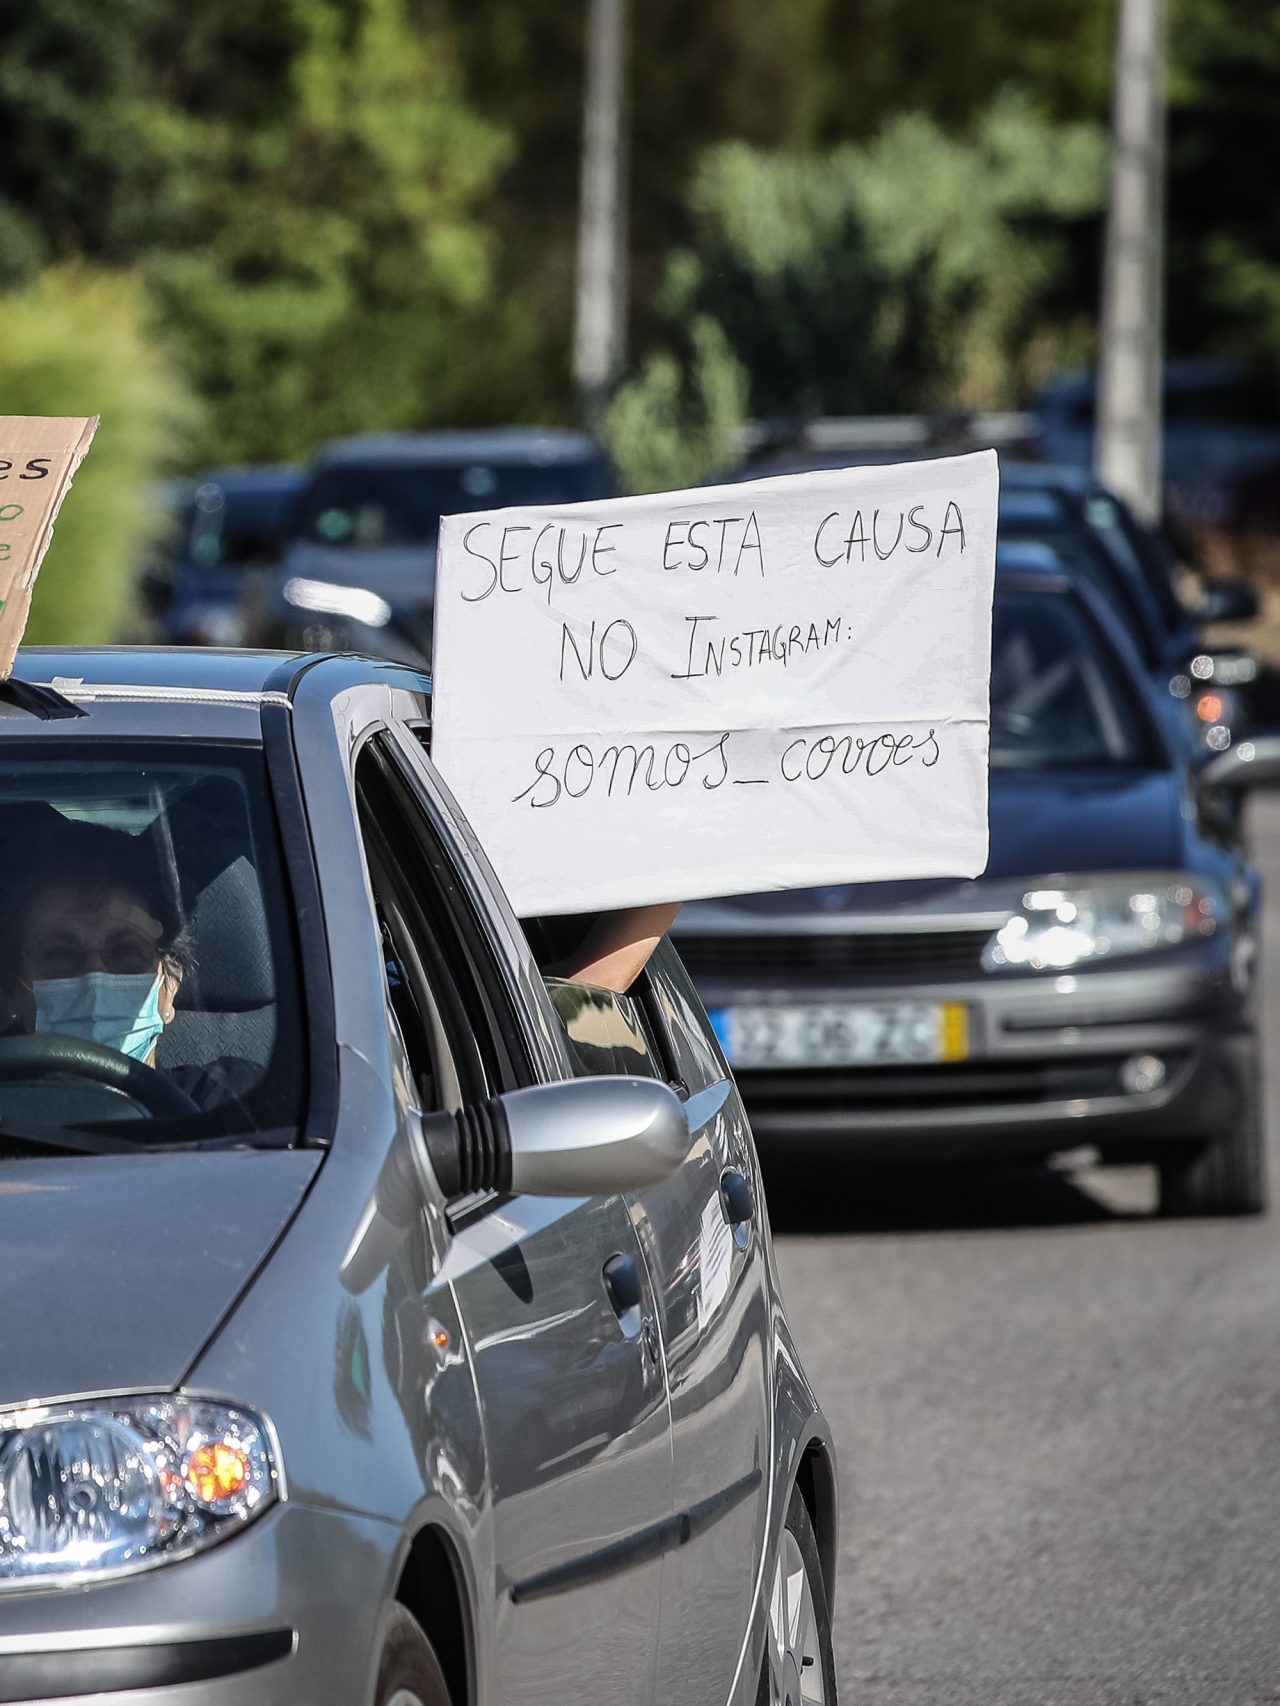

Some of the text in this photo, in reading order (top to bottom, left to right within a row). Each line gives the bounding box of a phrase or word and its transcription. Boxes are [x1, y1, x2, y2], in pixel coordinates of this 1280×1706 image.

[460, 501, 968, 606] SEGUE ESTA CAUSA
[559, 618, 638, 682] NO
